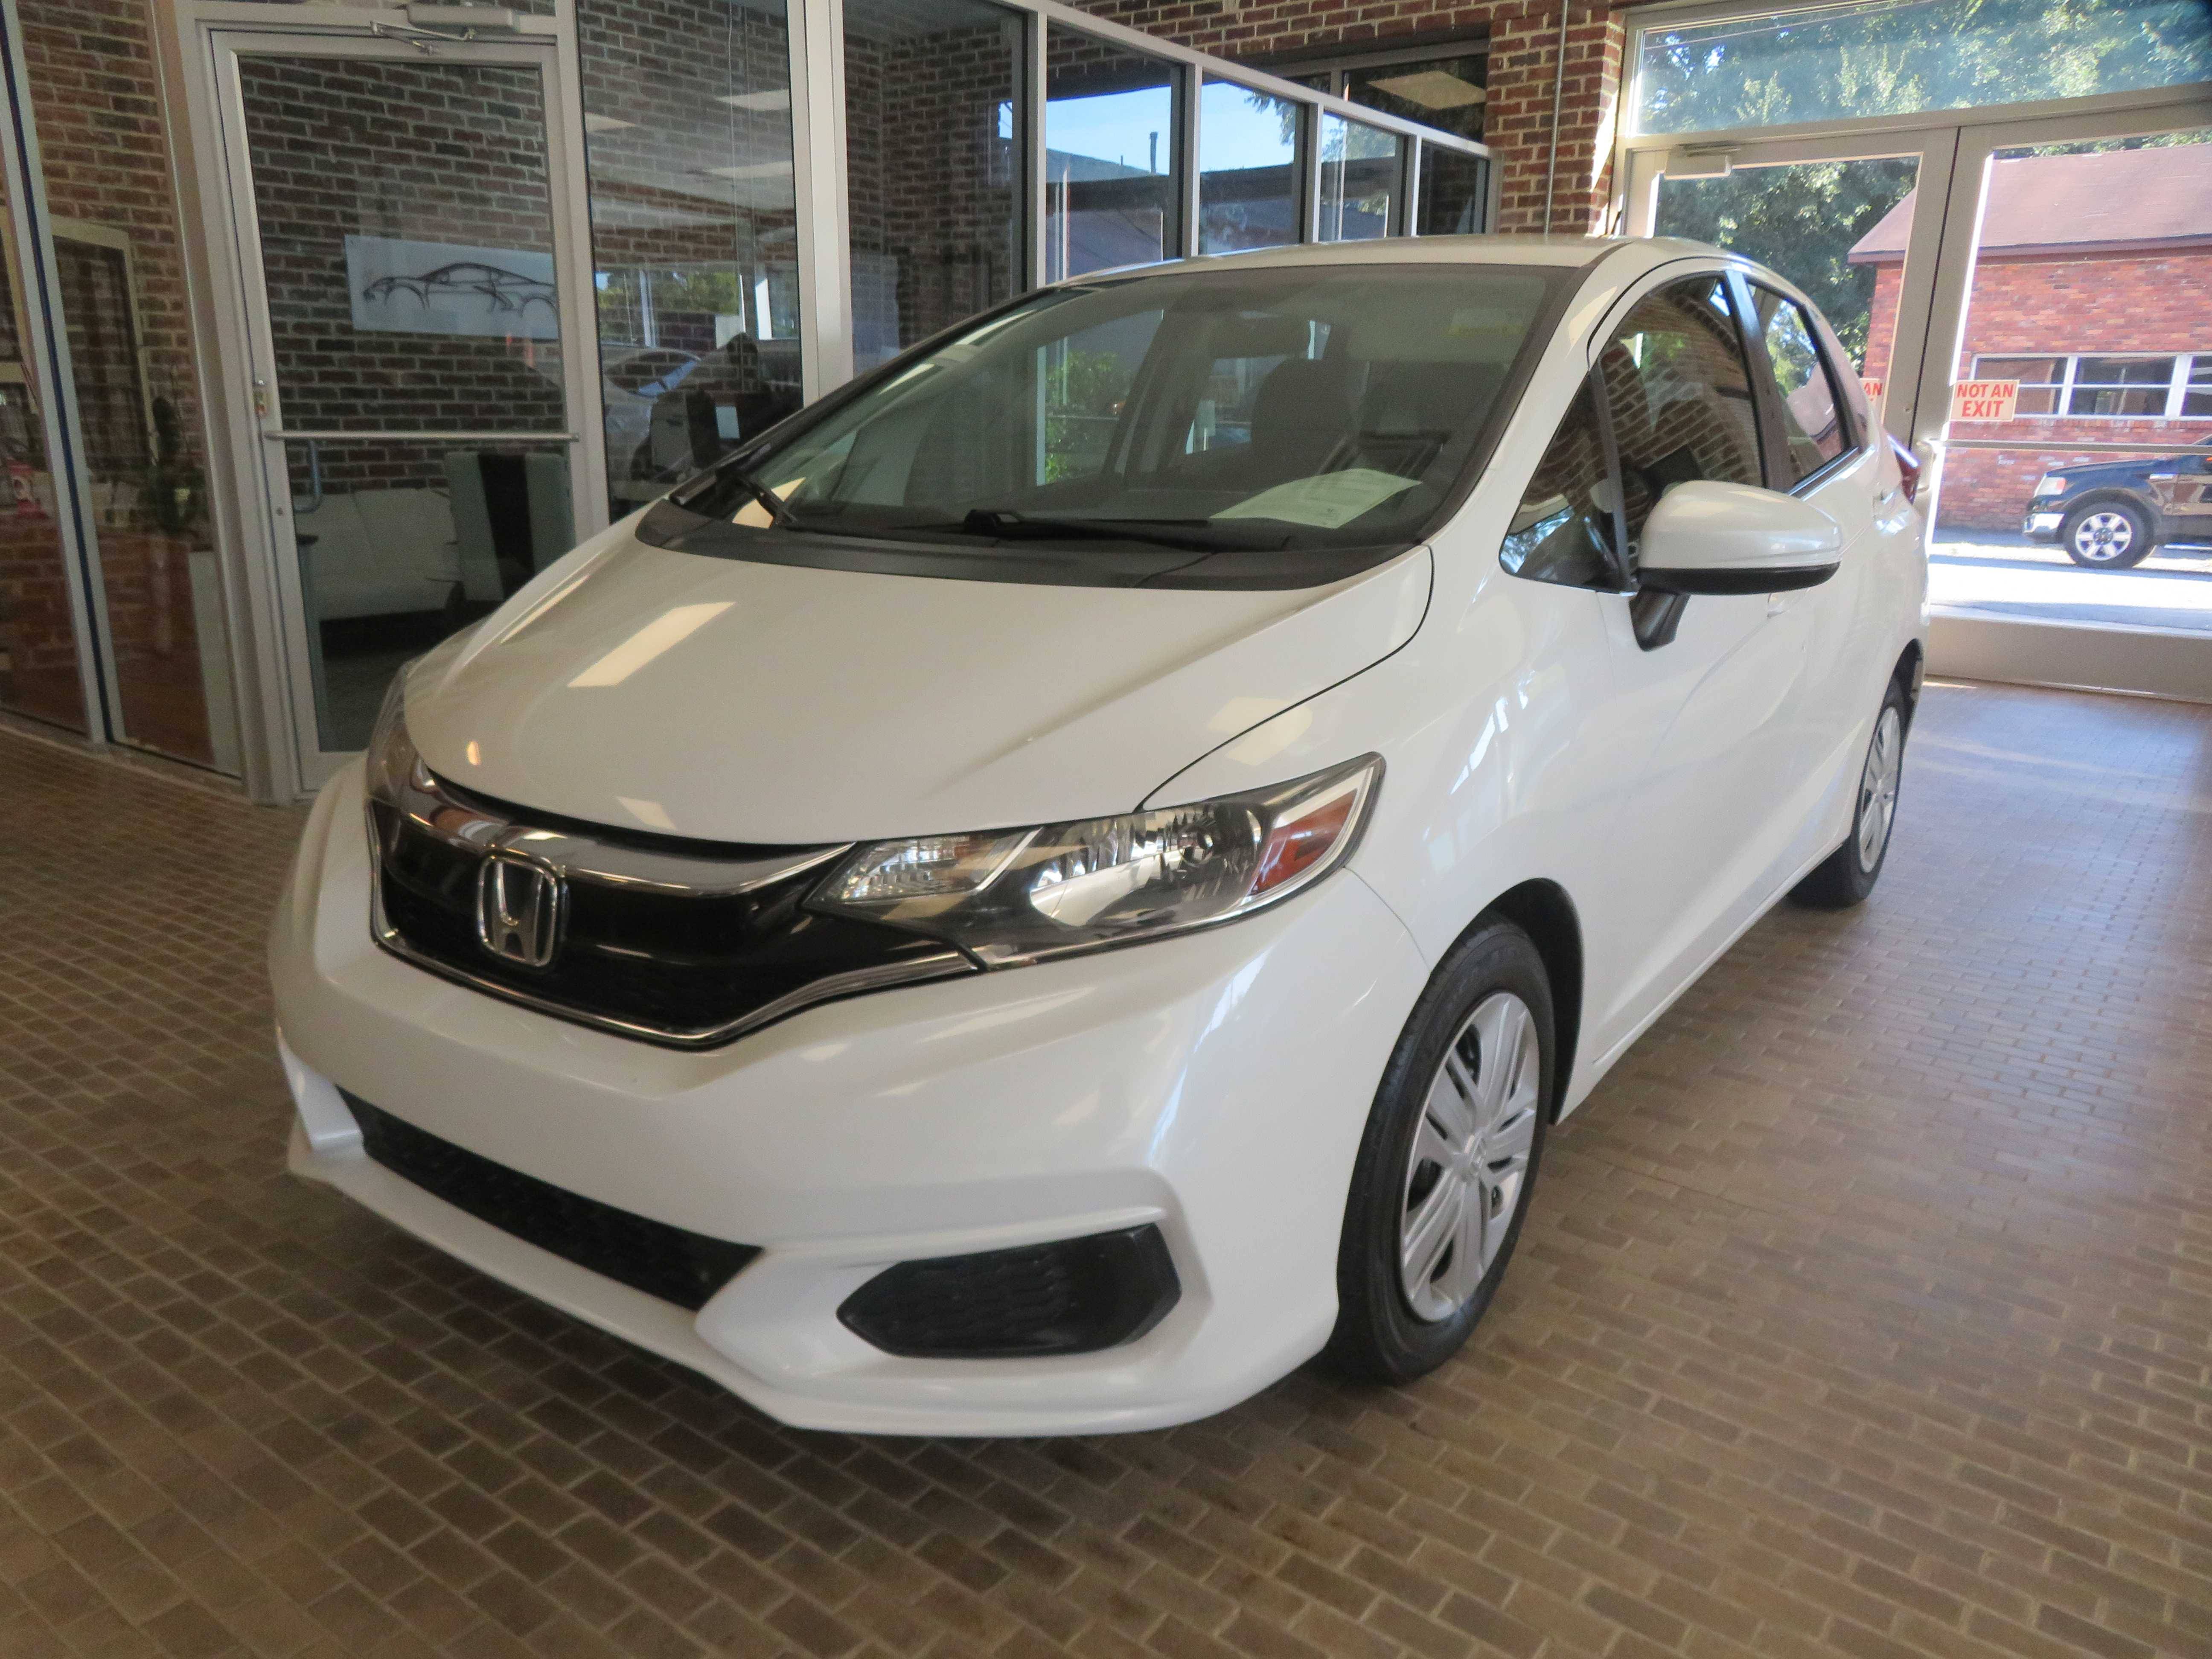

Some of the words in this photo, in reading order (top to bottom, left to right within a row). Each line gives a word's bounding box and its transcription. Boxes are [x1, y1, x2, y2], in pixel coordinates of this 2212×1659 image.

[1957, 384, 1989, 398] NOT
[1991, 384, 2014, 398] AN
[1961, 400, 2004, 417] EXIT
